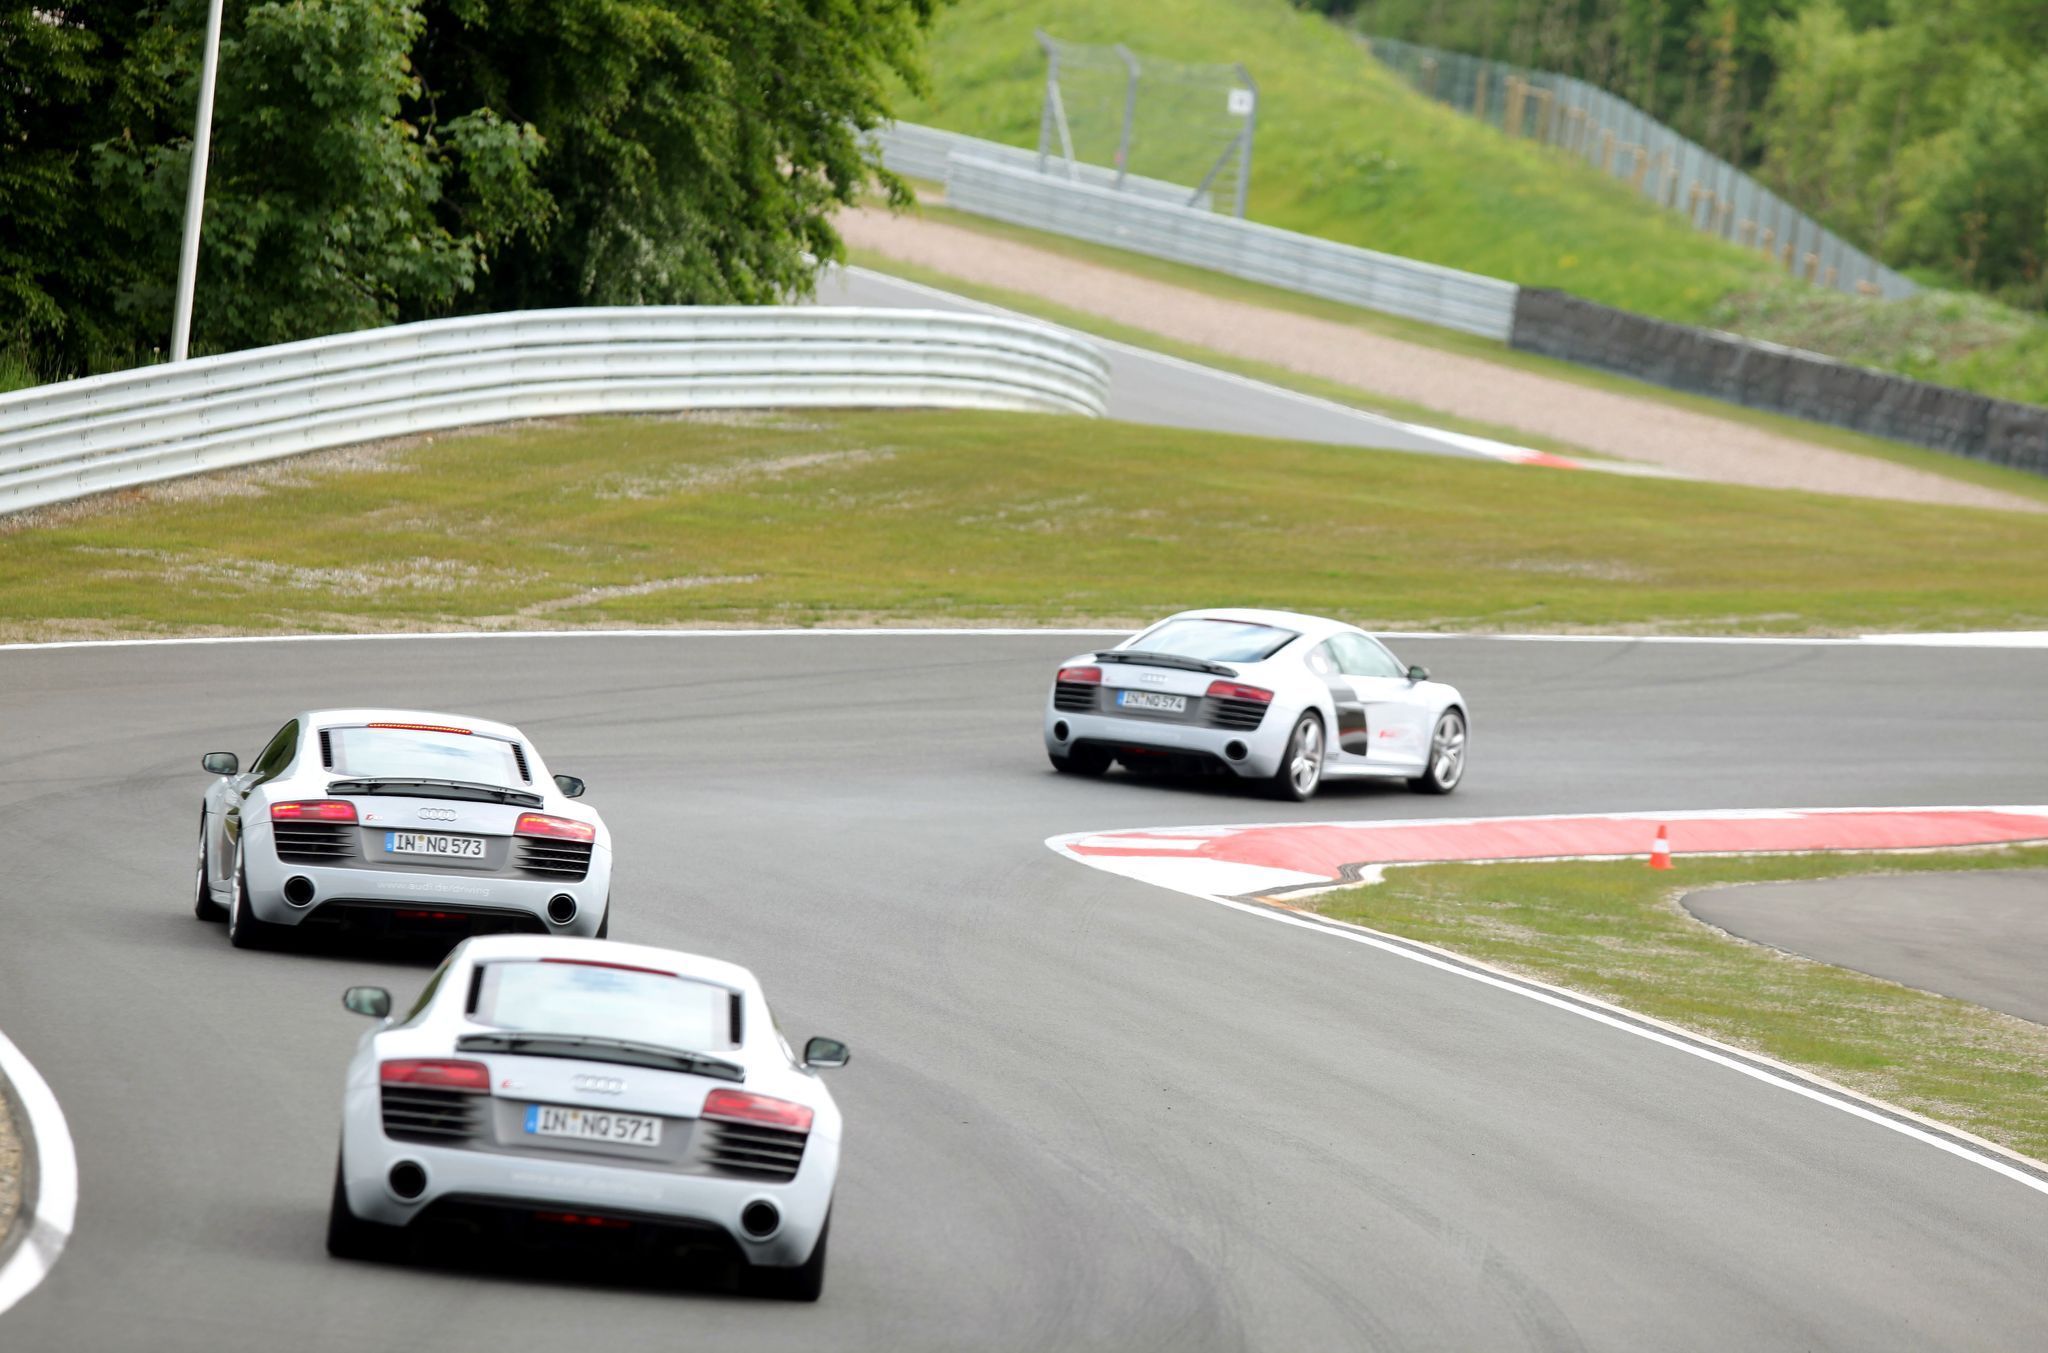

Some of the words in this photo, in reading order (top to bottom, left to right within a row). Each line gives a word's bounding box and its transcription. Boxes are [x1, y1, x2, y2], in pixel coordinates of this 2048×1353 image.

[1161, 696, 1183, 710] 574
[396, 834, 416, 851] IN
[451, 838, 481, 855] 573
[541, 1110, 567, 1132] IN
[615, 1118, 654, 1142] 571
